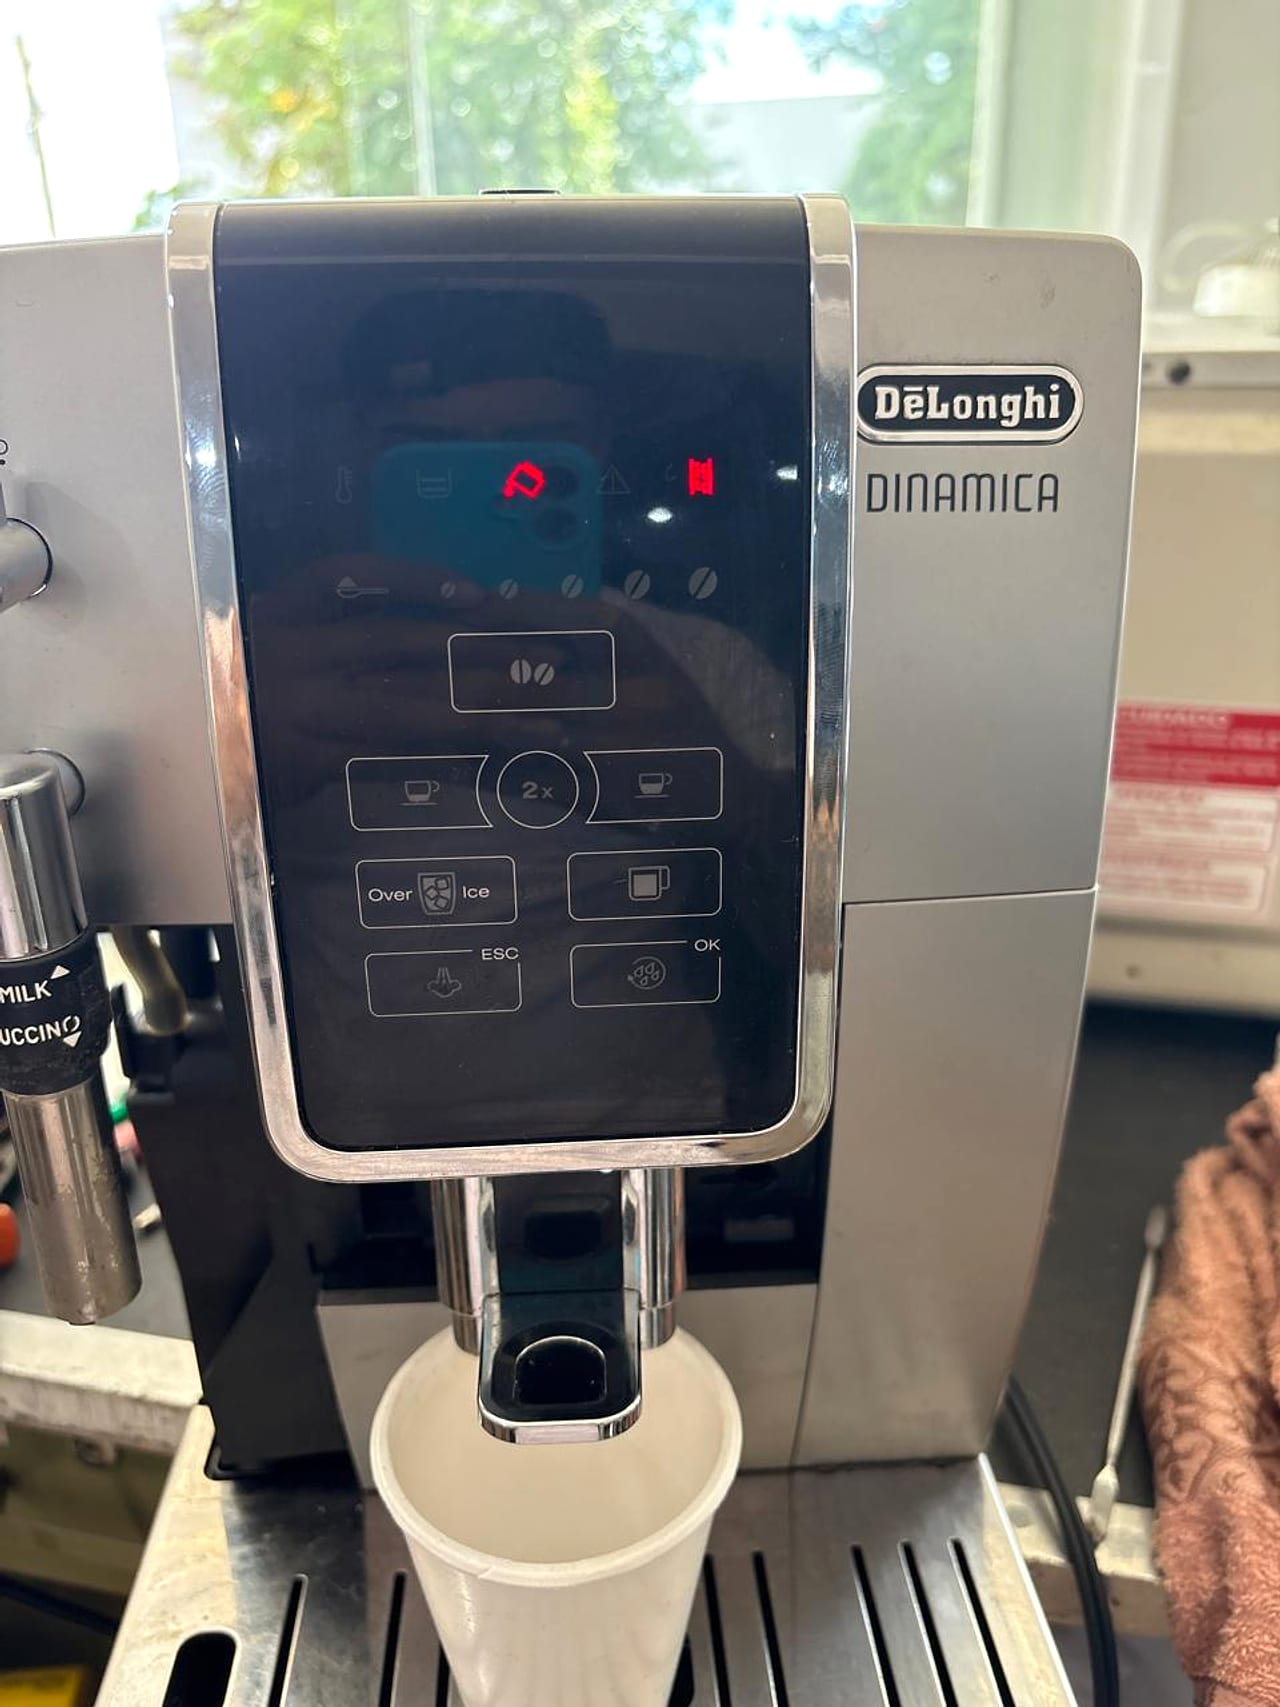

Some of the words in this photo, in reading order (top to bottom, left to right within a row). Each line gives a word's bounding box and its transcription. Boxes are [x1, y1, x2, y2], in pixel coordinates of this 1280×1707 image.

[866, 473, 1059, 513] DINAMICA
[521, 781, 554, 800] 2x
[368, 888, 413, 902] Over
[462, 886, 490, 900] Ice
[694, 938, 721, 952] OK
[481, 947, 519, 961] ESC
[0, 979, 52, 1004] MILK
